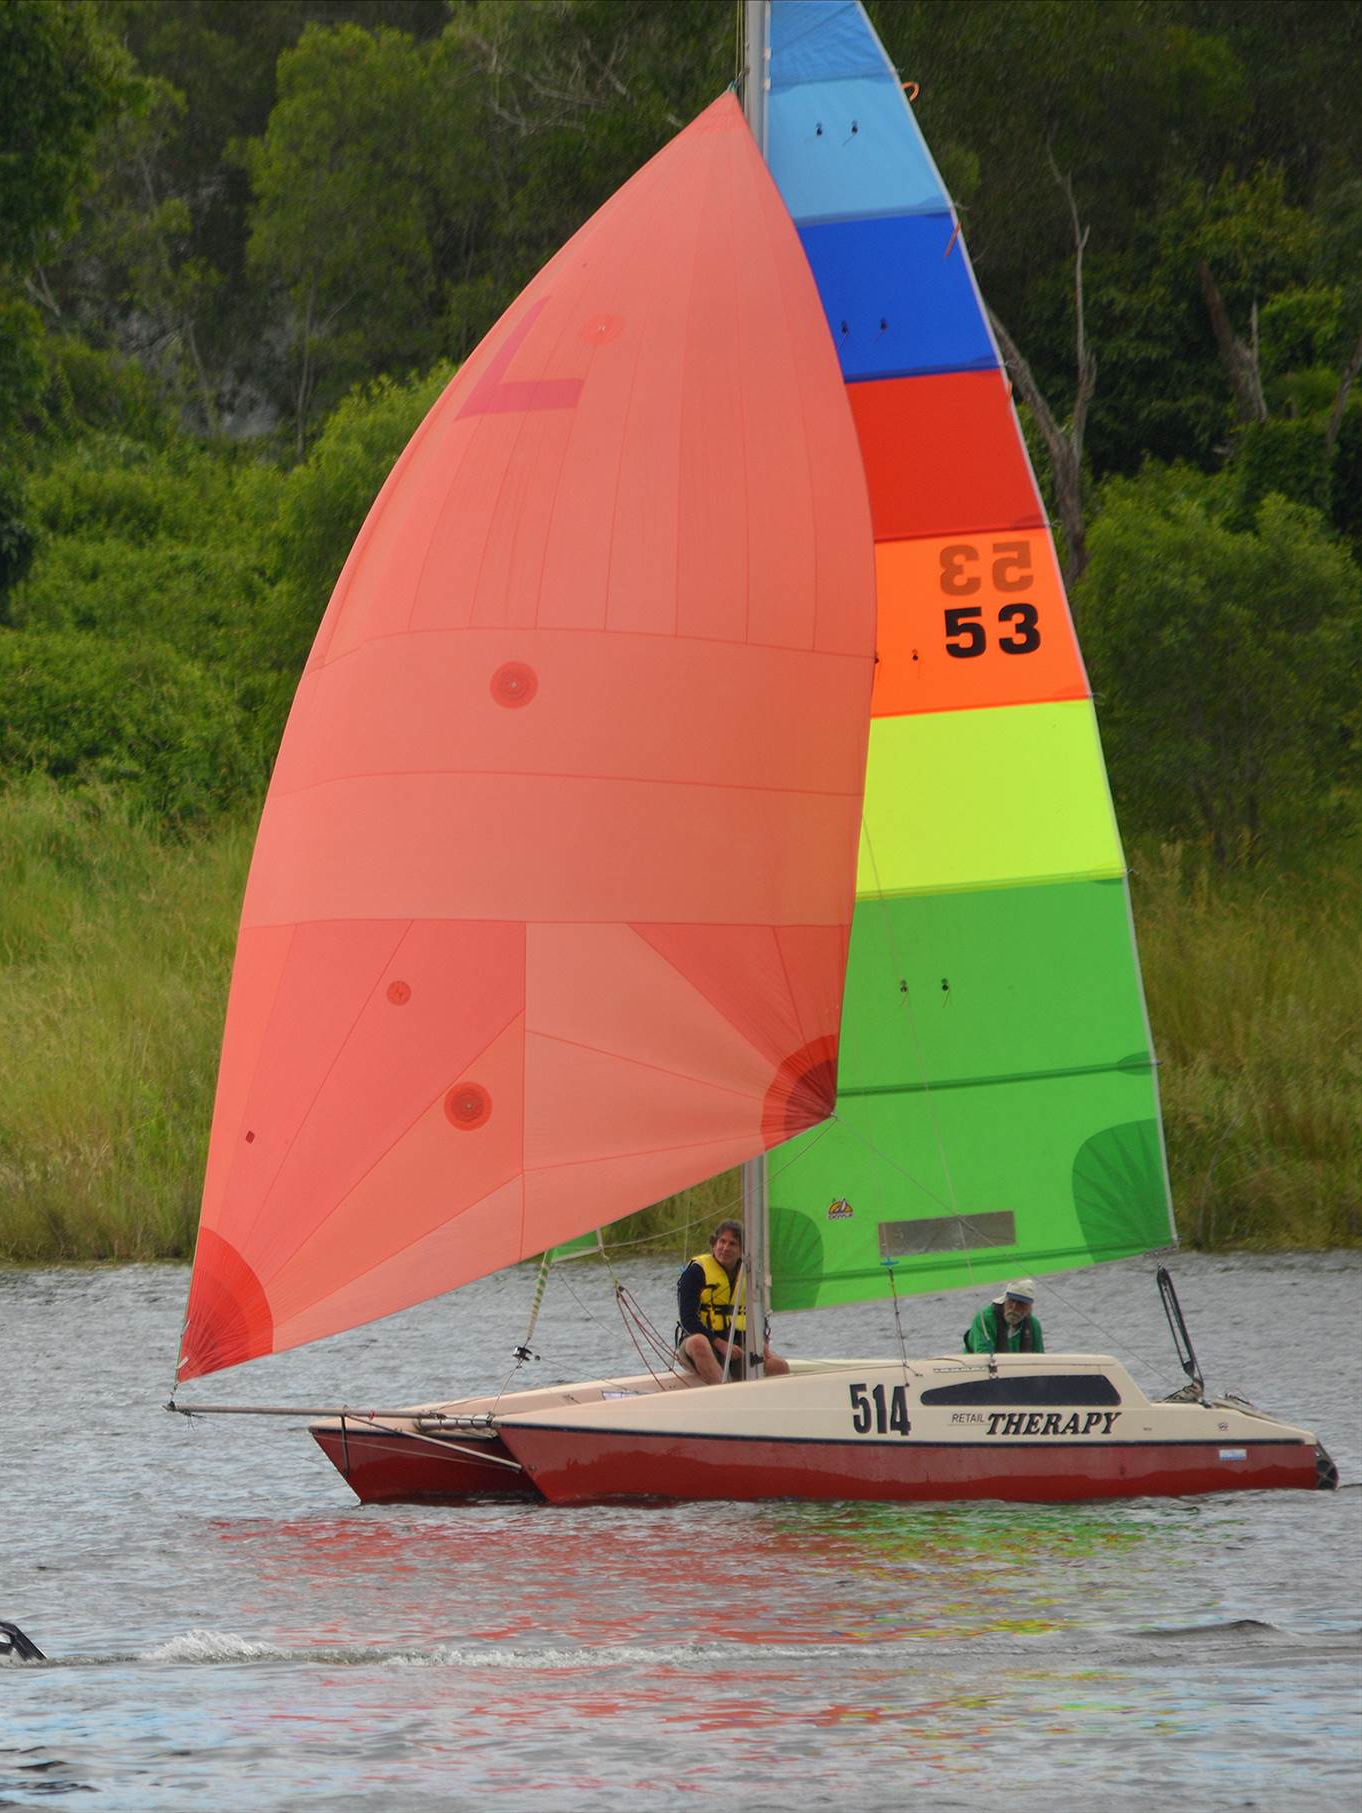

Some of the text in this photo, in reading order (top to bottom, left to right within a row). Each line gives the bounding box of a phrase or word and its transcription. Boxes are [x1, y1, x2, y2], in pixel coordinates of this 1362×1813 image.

[944, 603, 1041, 658] 53
[849, 1383, 911, 1436] 514
[951, 1412, 1122, 1435] RETAIL THERAPY
